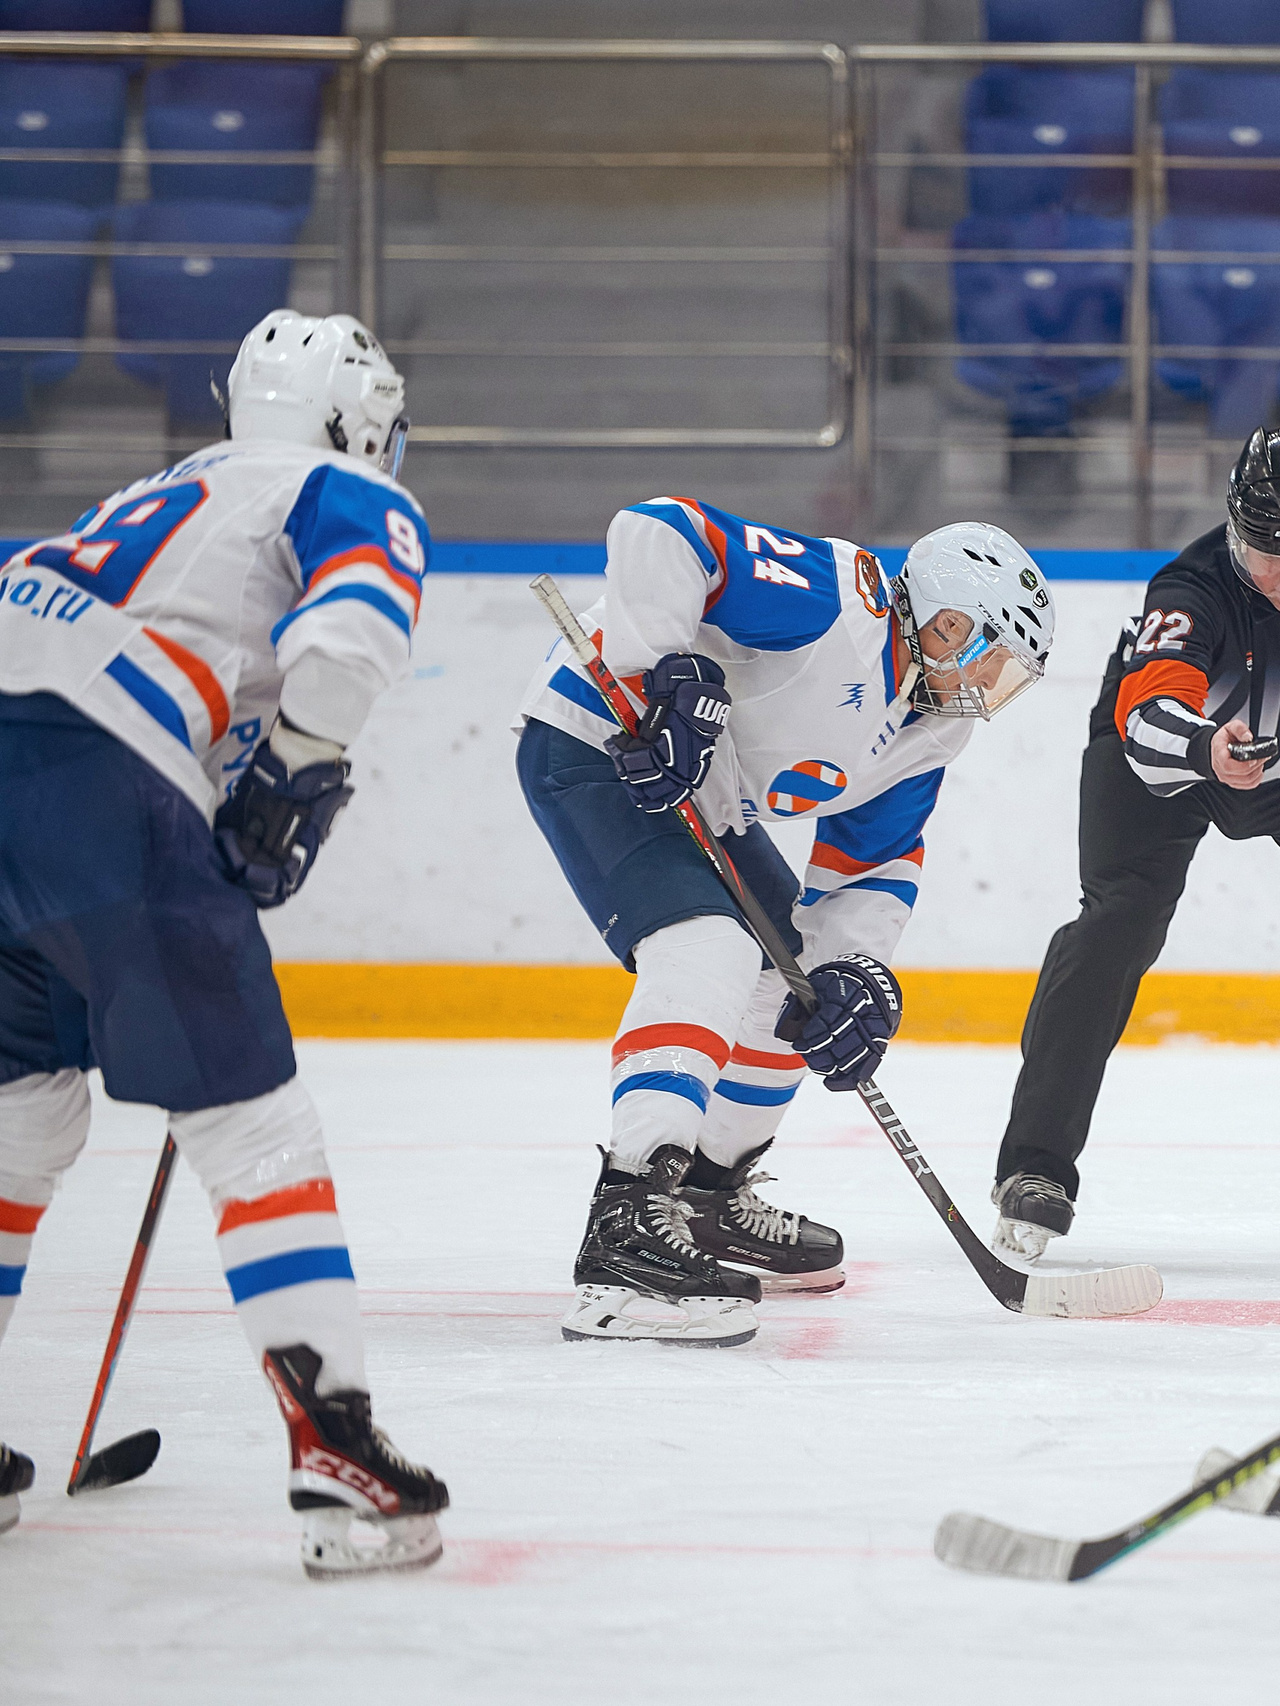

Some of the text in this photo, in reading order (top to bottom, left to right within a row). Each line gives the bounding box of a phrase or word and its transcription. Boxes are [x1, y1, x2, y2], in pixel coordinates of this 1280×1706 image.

[385, 508, 426, 577] 9
[743, 525, 810, 590] 24
[1135, 608, 1194, 655] 22
